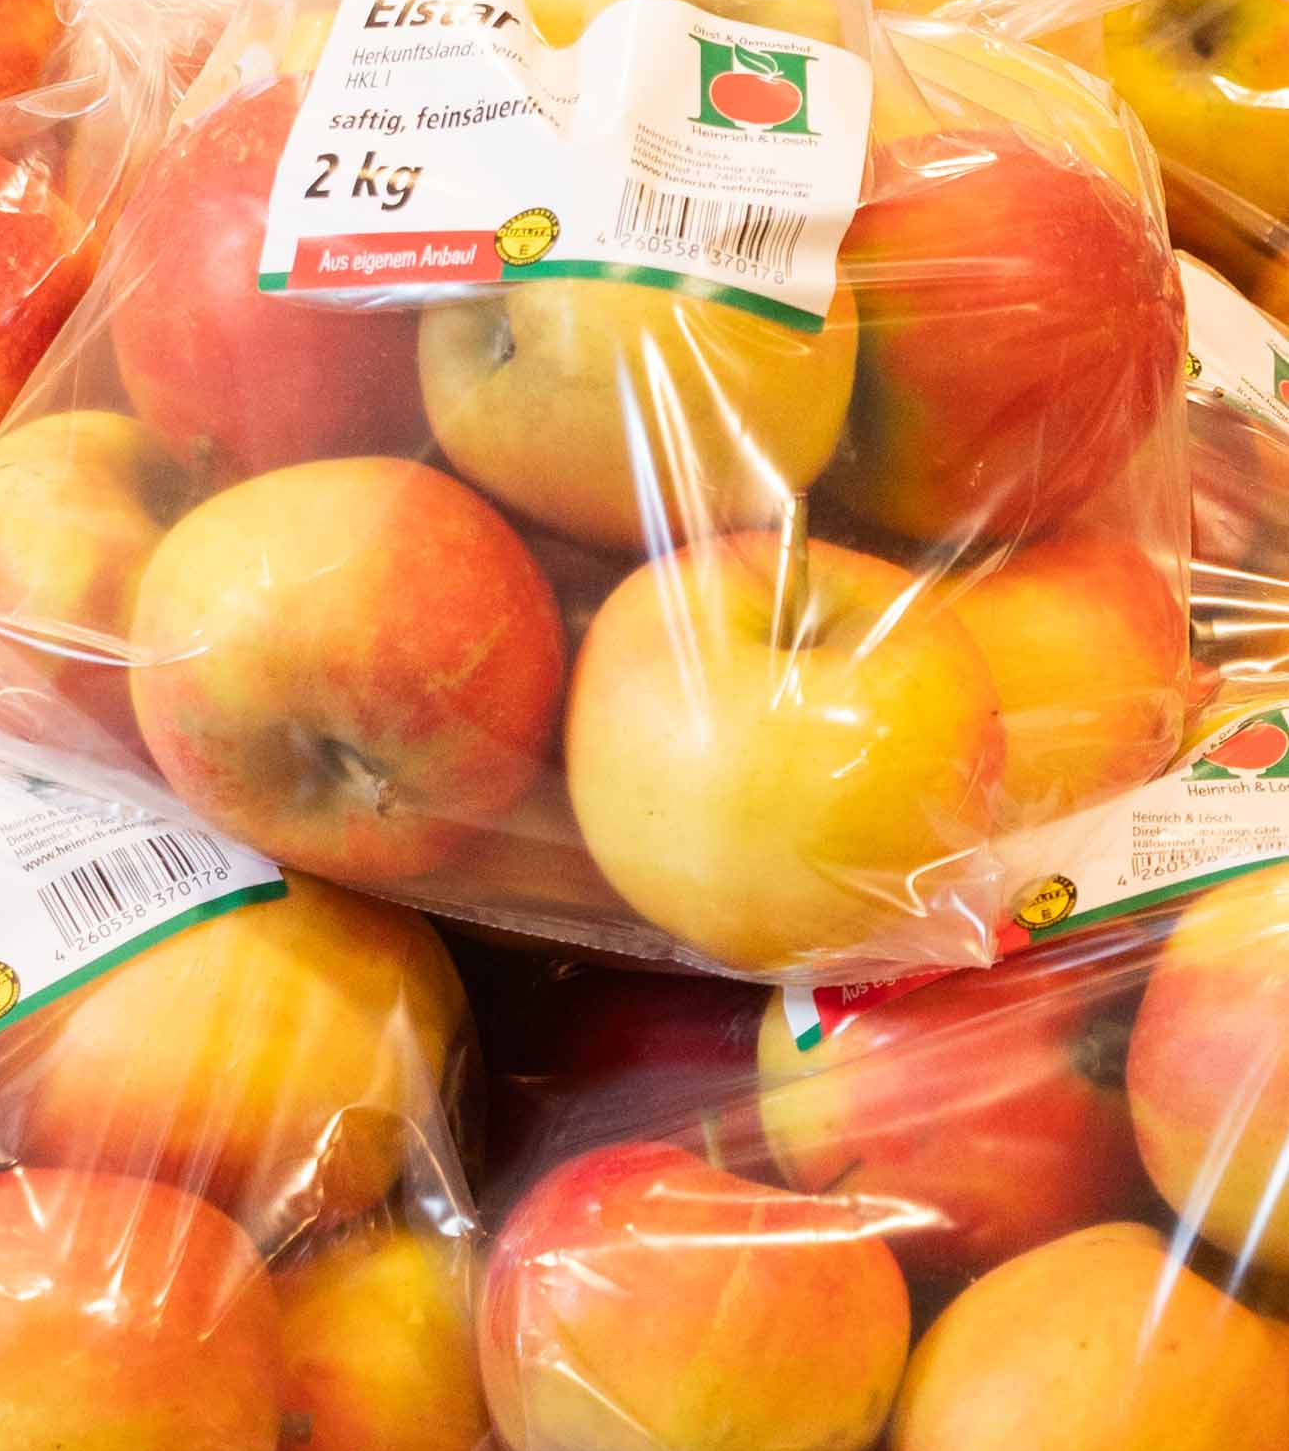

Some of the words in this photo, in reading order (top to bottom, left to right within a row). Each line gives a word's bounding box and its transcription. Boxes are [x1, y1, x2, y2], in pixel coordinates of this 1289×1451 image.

[345, 71, 379, 90] HKL
[329, 108, 406, 136] saftig,
[416, 93, 562, 131] feinsäuerl
[303, 152, 340, 199] 2
[351, 150, 425, 212] kg
[318, 248, 349, 273] Aus
[352, 250, 417, 275] eigenem
[420, 243, 478, 268] Anbau!
[620, 232, 701, 260] 260558
[709, 249, 785, 286] 370178
[1187, 779, 1251, 798] Heinrich
[1254, 780, 1266, 793] &
[1132, 811, 1182, 823] Heinrich
[1116, 873, 1128, 886] 4
[54, 949, 66, 962] 4
[74, 902, 148, 953] 260558
[152, 865, 229, 910] 370178
